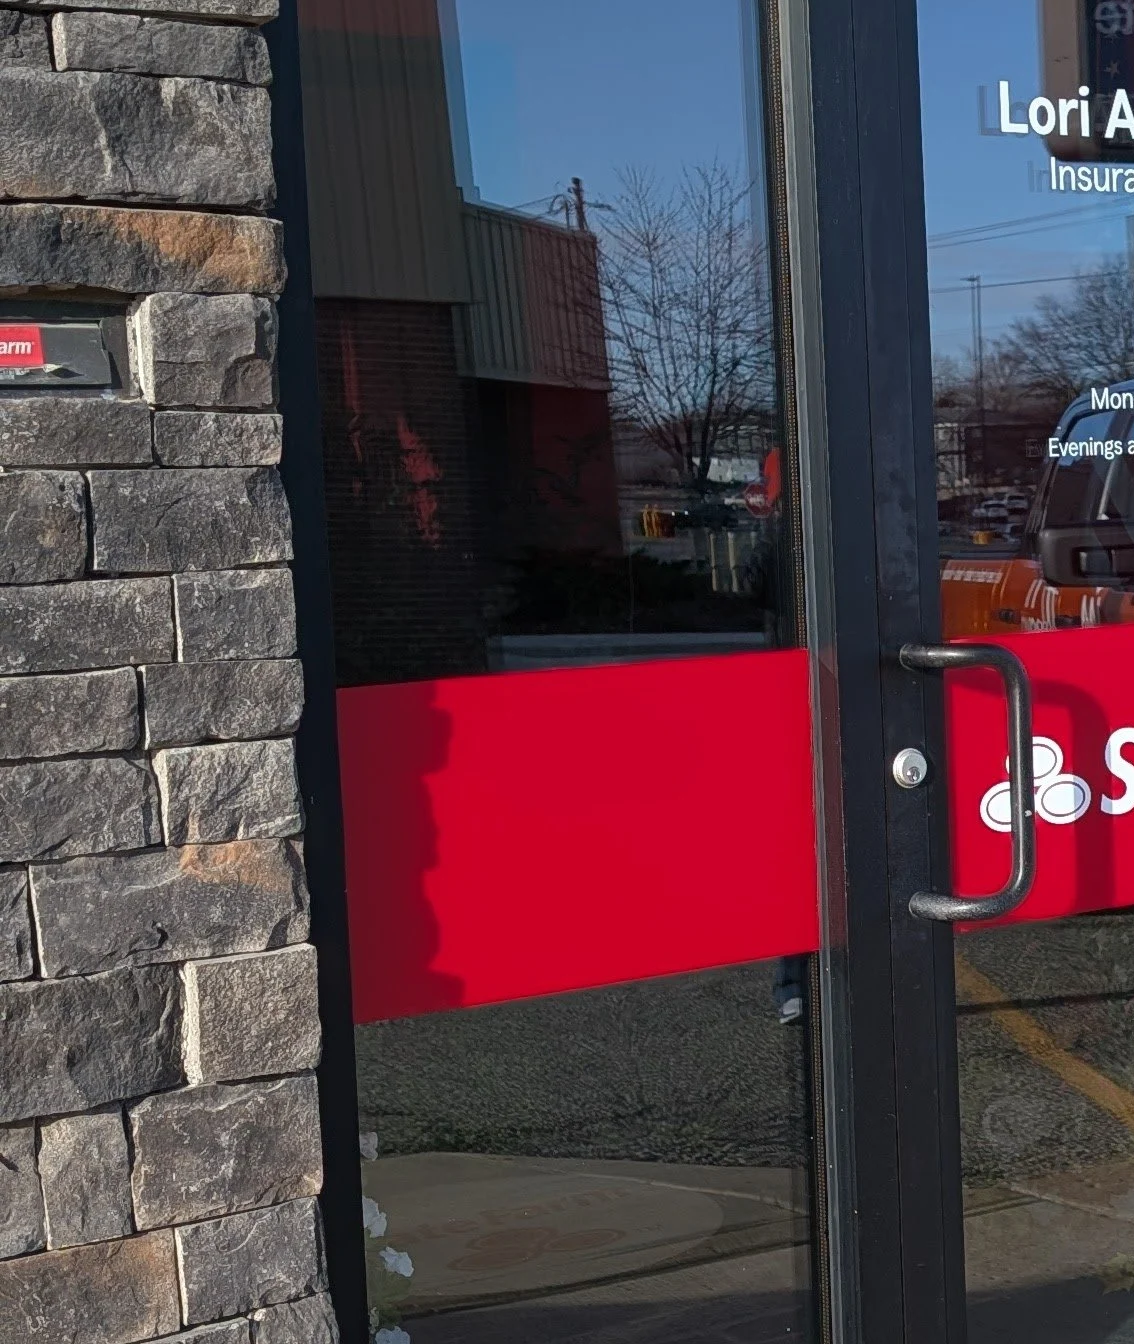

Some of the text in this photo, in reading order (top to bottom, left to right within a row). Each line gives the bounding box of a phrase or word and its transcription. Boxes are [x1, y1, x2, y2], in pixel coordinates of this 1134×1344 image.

[999, 80, 1090, 137] Lori
[0, 341, 32, 355] arm
[1048, 437, 1123, 460] Evenings
